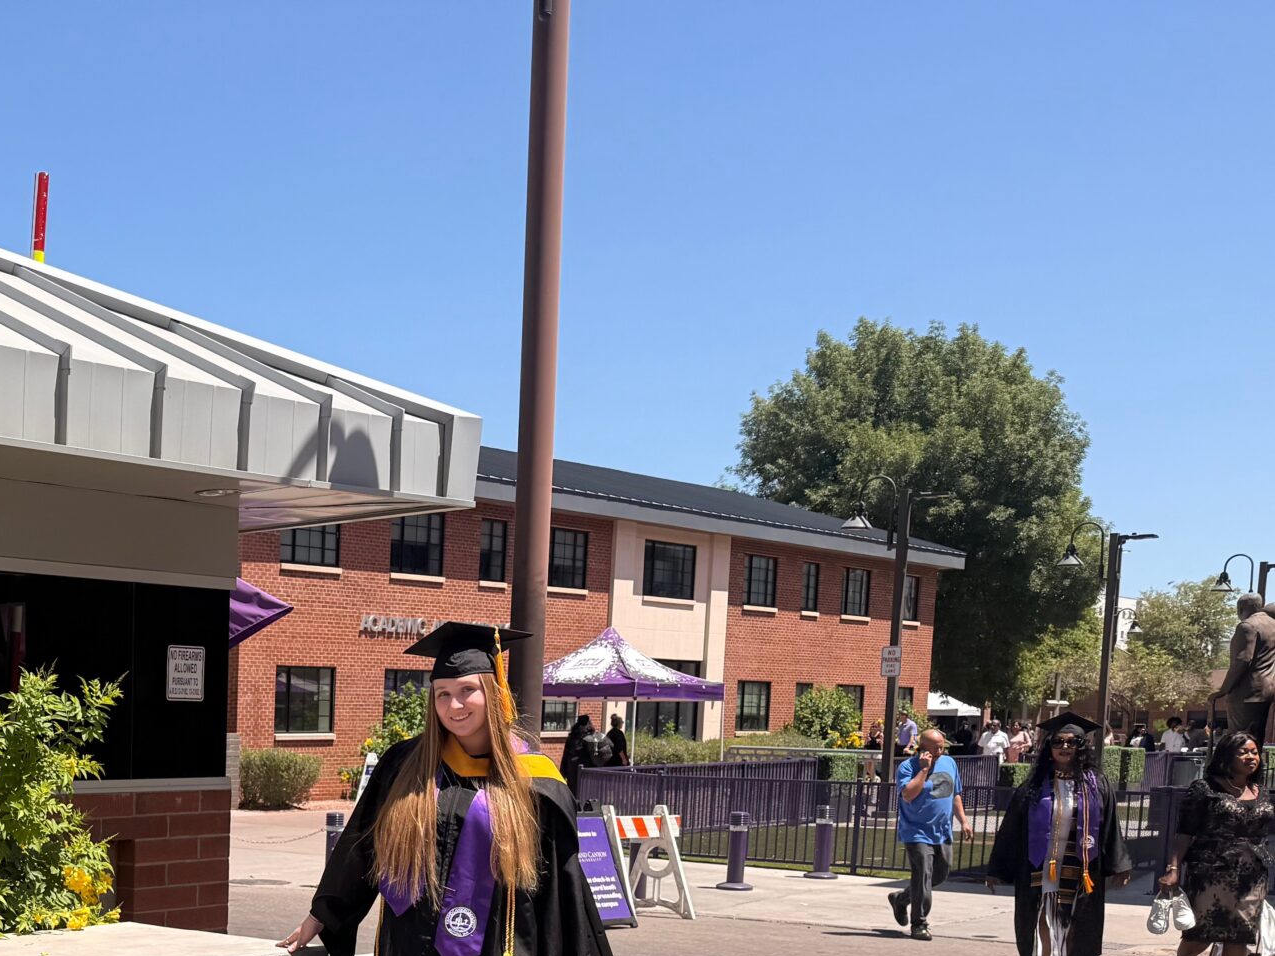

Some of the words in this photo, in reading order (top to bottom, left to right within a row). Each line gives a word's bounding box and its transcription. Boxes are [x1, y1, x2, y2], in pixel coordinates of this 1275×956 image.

[360, 614, 427, 633] ACADEMIC
[171, 650, 178, 660] NO
[174, 663, 197, 673] ALLOWED
